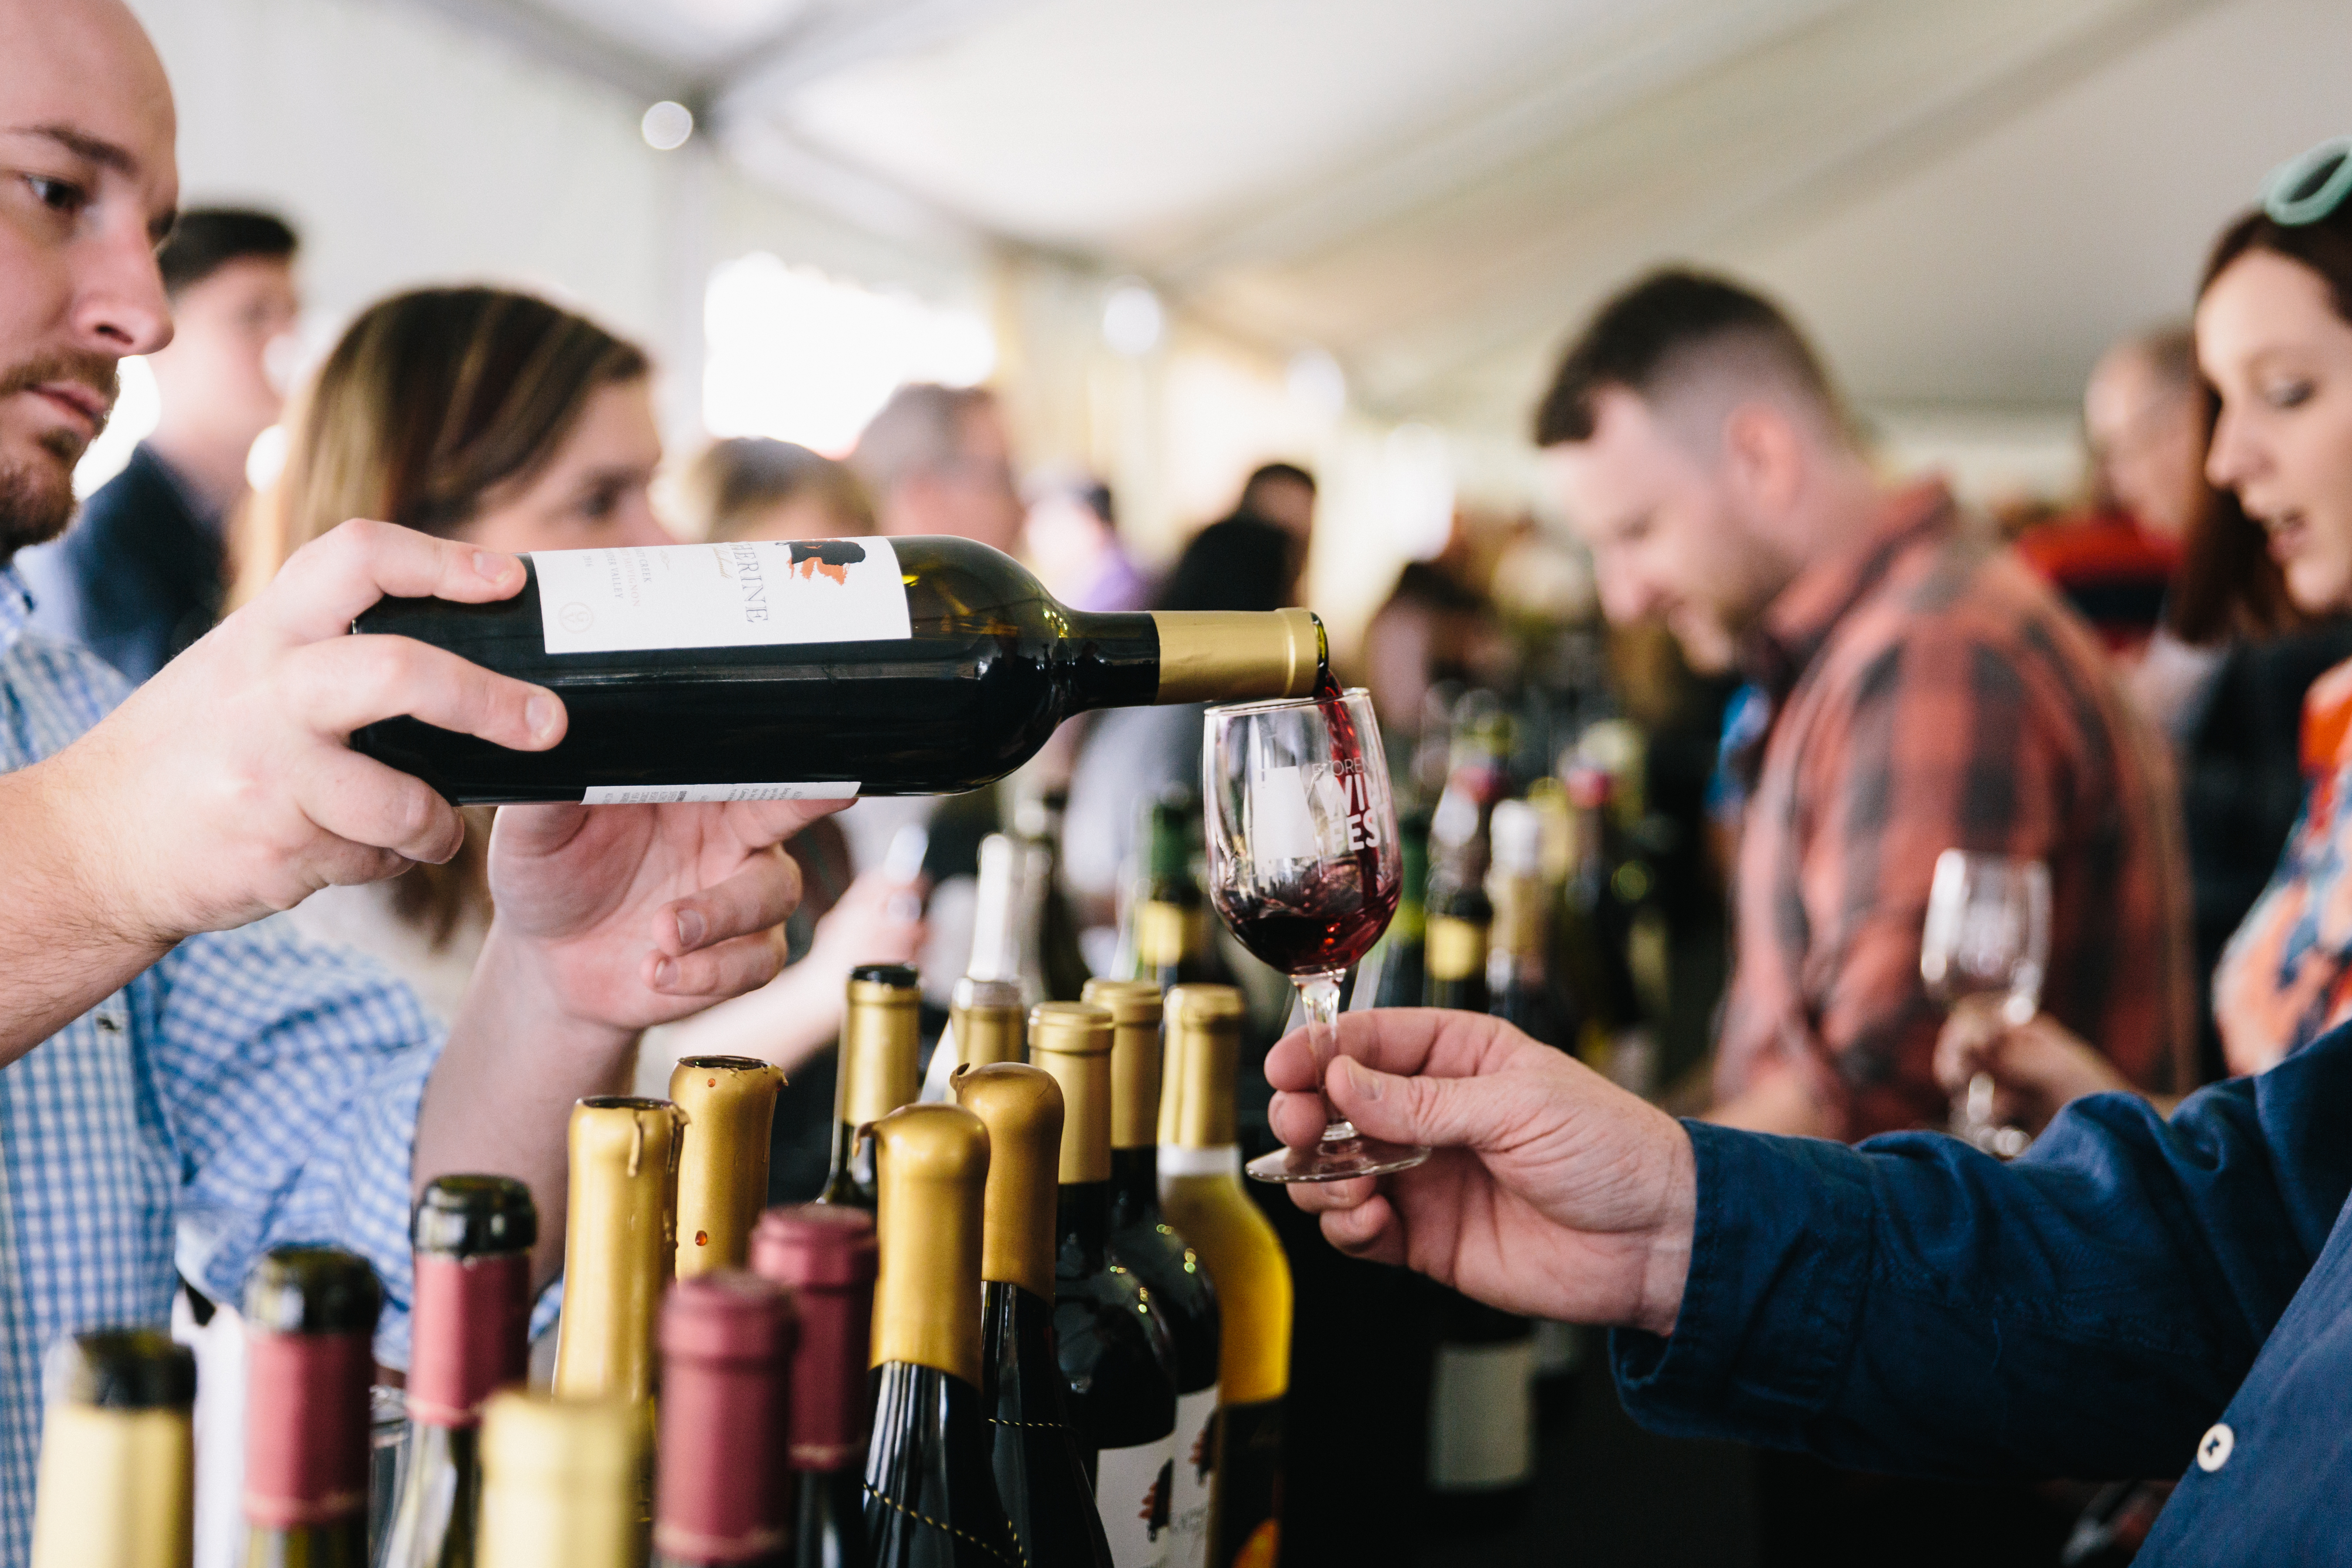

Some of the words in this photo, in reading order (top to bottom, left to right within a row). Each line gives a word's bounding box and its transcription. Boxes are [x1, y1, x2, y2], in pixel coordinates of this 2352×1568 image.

[583, 555, 594, 567] 2016
[603, 547, 617, 566] ANDER
[611, 568, 624, 599] VALLEY
[623, 557, 641, 607] SAUVIGNON
[639, 559, 652, 583] CREEK
[1314, 772, 1385, 821] WIN
[1329, 802, 1391, 854] FEST
